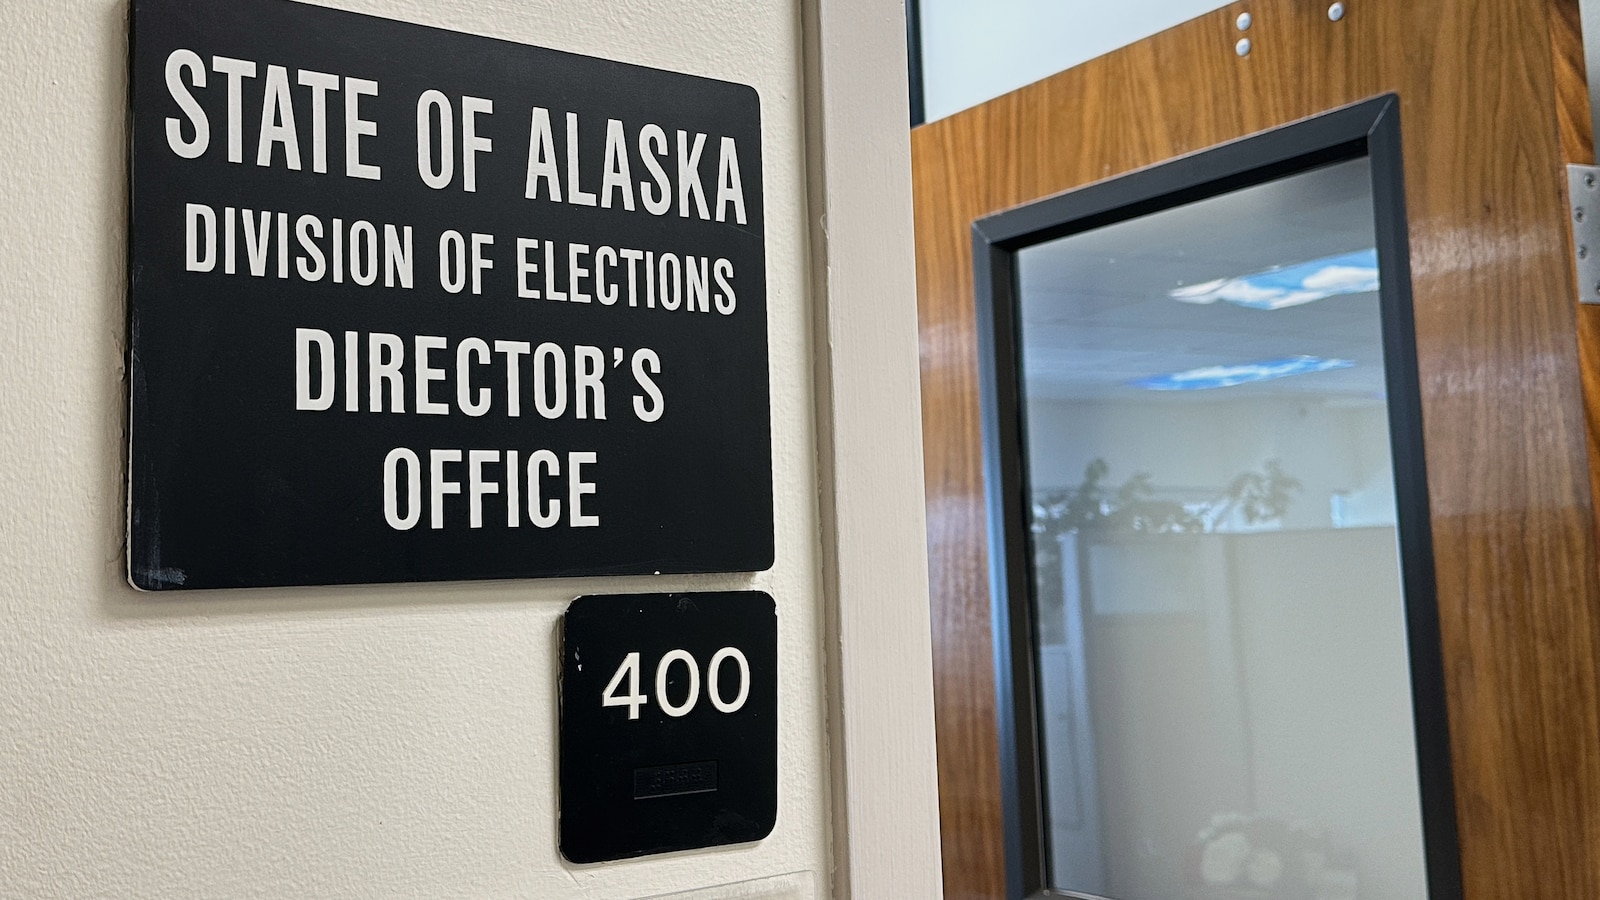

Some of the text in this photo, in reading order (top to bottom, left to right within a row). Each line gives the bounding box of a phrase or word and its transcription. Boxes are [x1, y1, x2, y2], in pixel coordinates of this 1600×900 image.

[165, 49, 748, 225] STATE OF ALASKA
[185, 203, 736, 316] DIVISION OF ELECTIONS
[295, 328, 665, 423] DIRECTOR’S
[383, 447, 600, 531] OFFICE
[602, 646, 751, 720] 400
